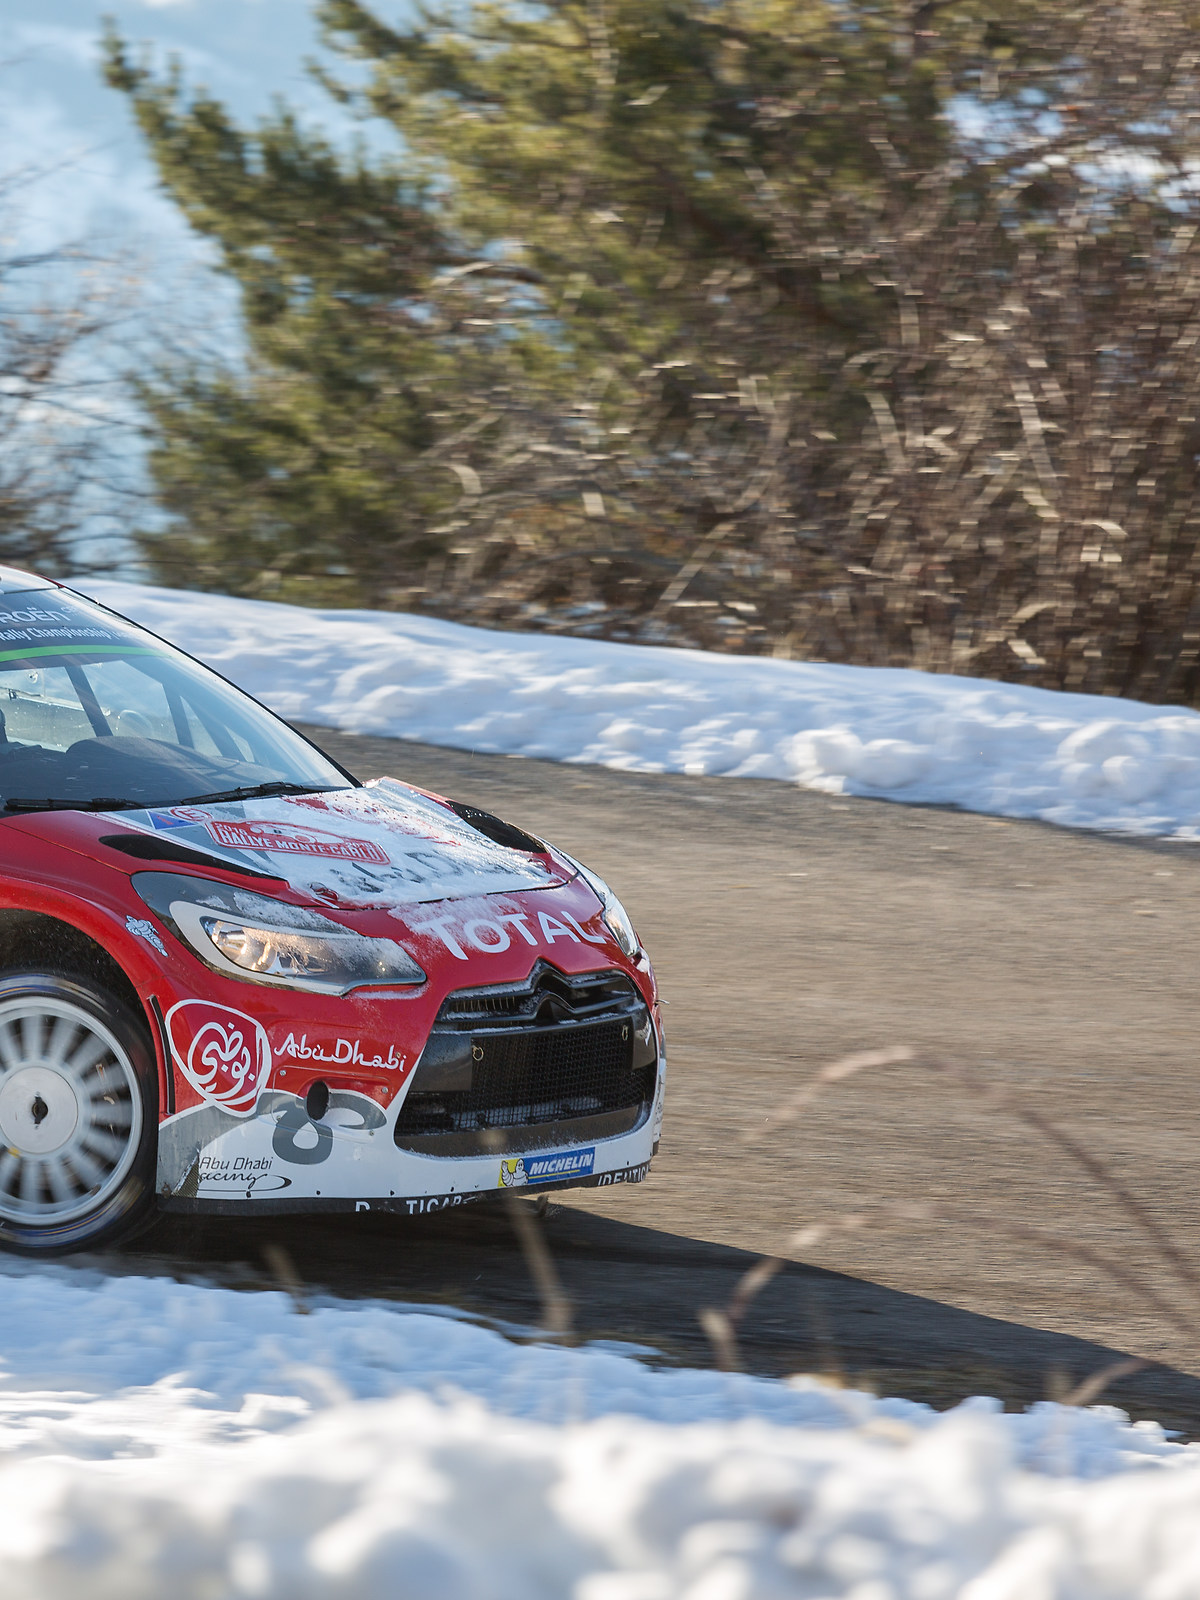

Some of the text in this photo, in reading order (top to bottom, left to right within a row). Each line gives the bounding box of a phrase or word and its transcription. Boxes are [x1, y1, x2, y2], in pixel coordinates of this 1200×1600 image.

[29, 626, 112, 640] Championship
[217, 829, 273, 848] RALLYE
[420, 910, 607, 960] TOTAL
[273, 1031, 407, 1072] Abu Dhabi
[199, 1156, 274, 1170] Abu Dhabi
[529, 1154, 593, 1175] MICHELIN
